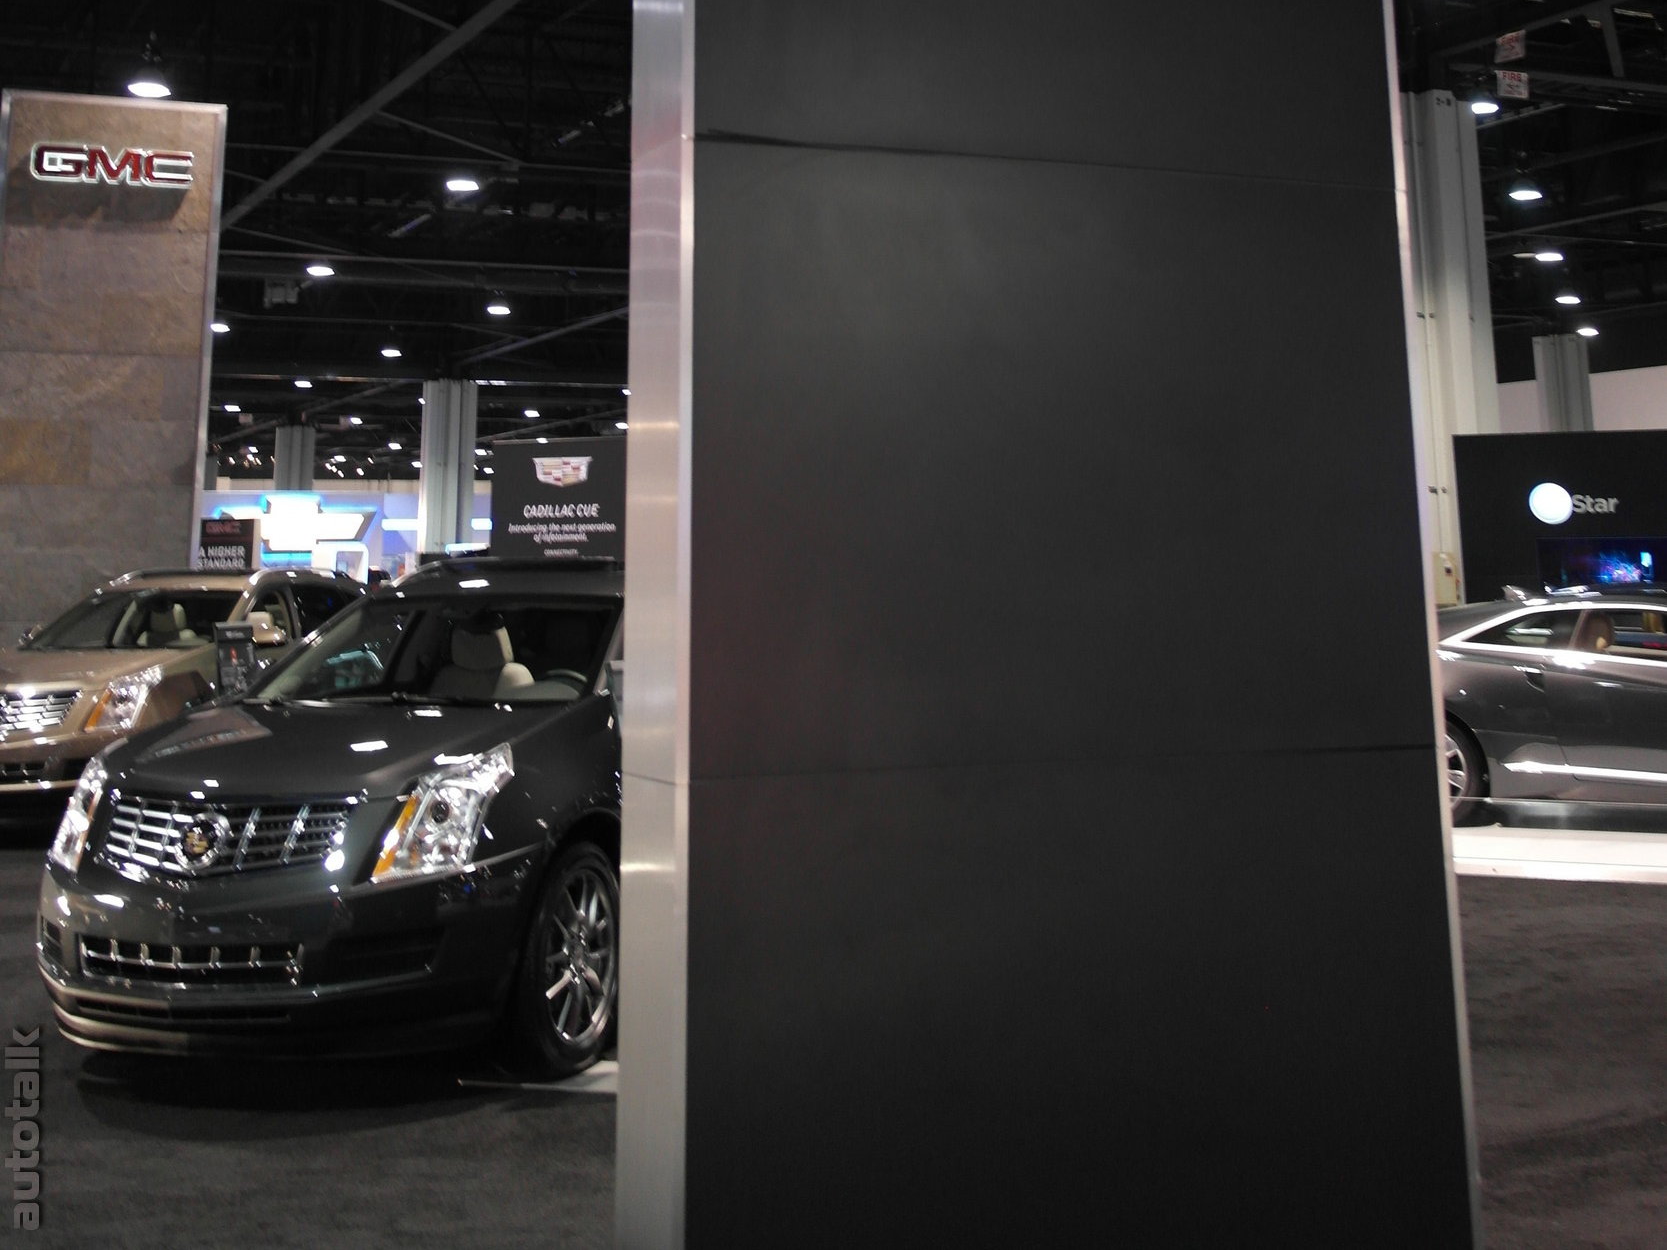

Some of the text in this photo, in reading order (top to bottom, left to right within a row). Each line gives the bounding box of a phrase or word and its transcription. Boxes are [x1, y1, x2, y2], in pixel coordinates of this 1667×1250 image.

[1502, 71, 1522, 82] FIRE
[30, 141, 194, 189] GMC
[524, 503, 600, 519] CADILLAC CUE
[508, 522, 616, 534] Introducing the next generation
[533, 533, 542, 544] of
[199, 545, 246, 559] A HIGHER
[197, 558, 246, 570] STANDARD
